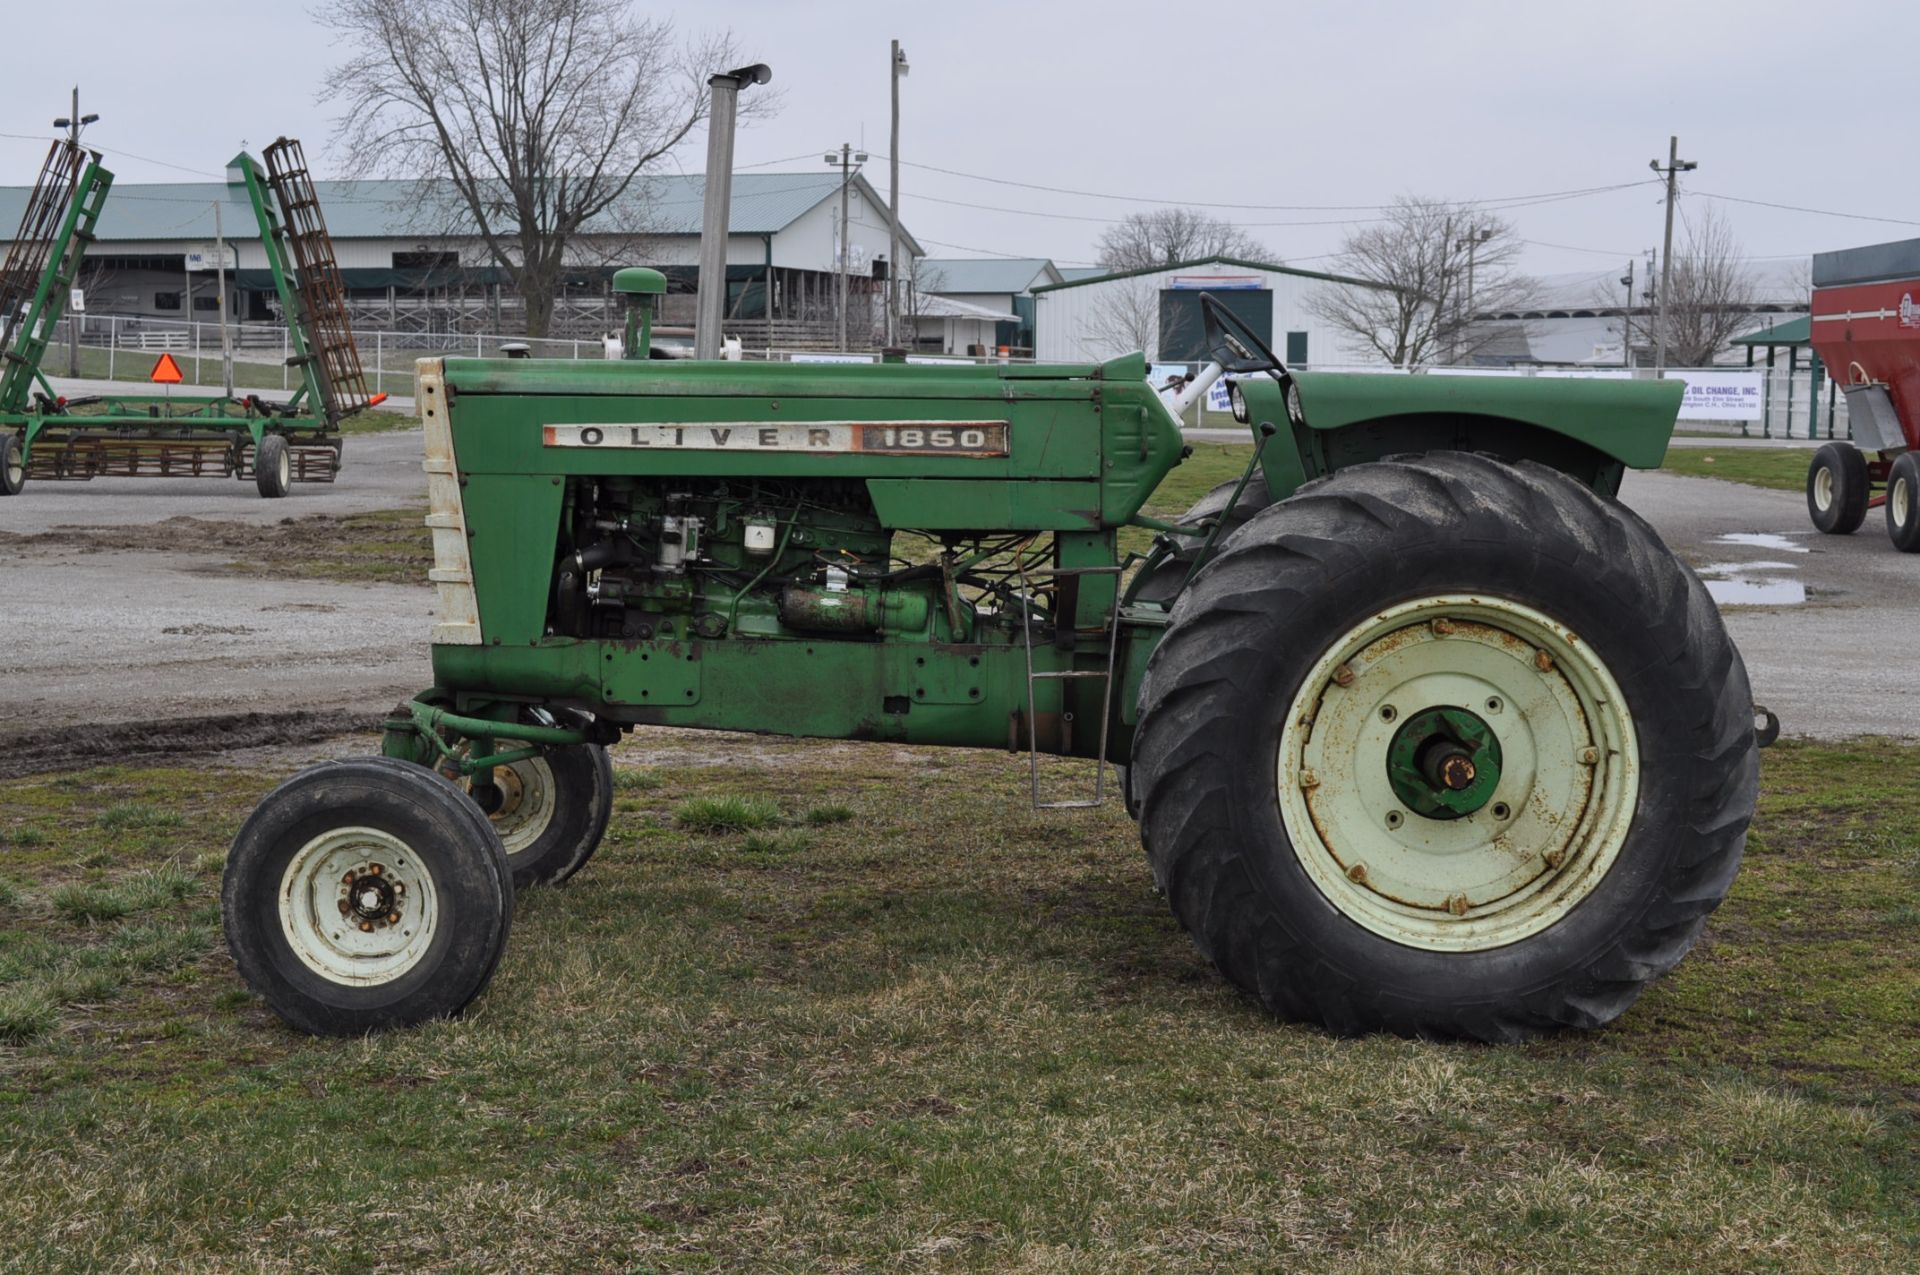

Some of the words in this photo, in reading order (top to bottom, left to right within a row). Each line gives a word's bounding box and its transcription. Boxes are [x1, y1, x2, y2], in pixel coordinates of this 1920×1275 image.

[1691, 386, 1705, 395] OIL
[1742, 387, 1759, 396] INC.
[580, 426, 830, 447] OLIVER
[884, 430, 985, 447] 1850
